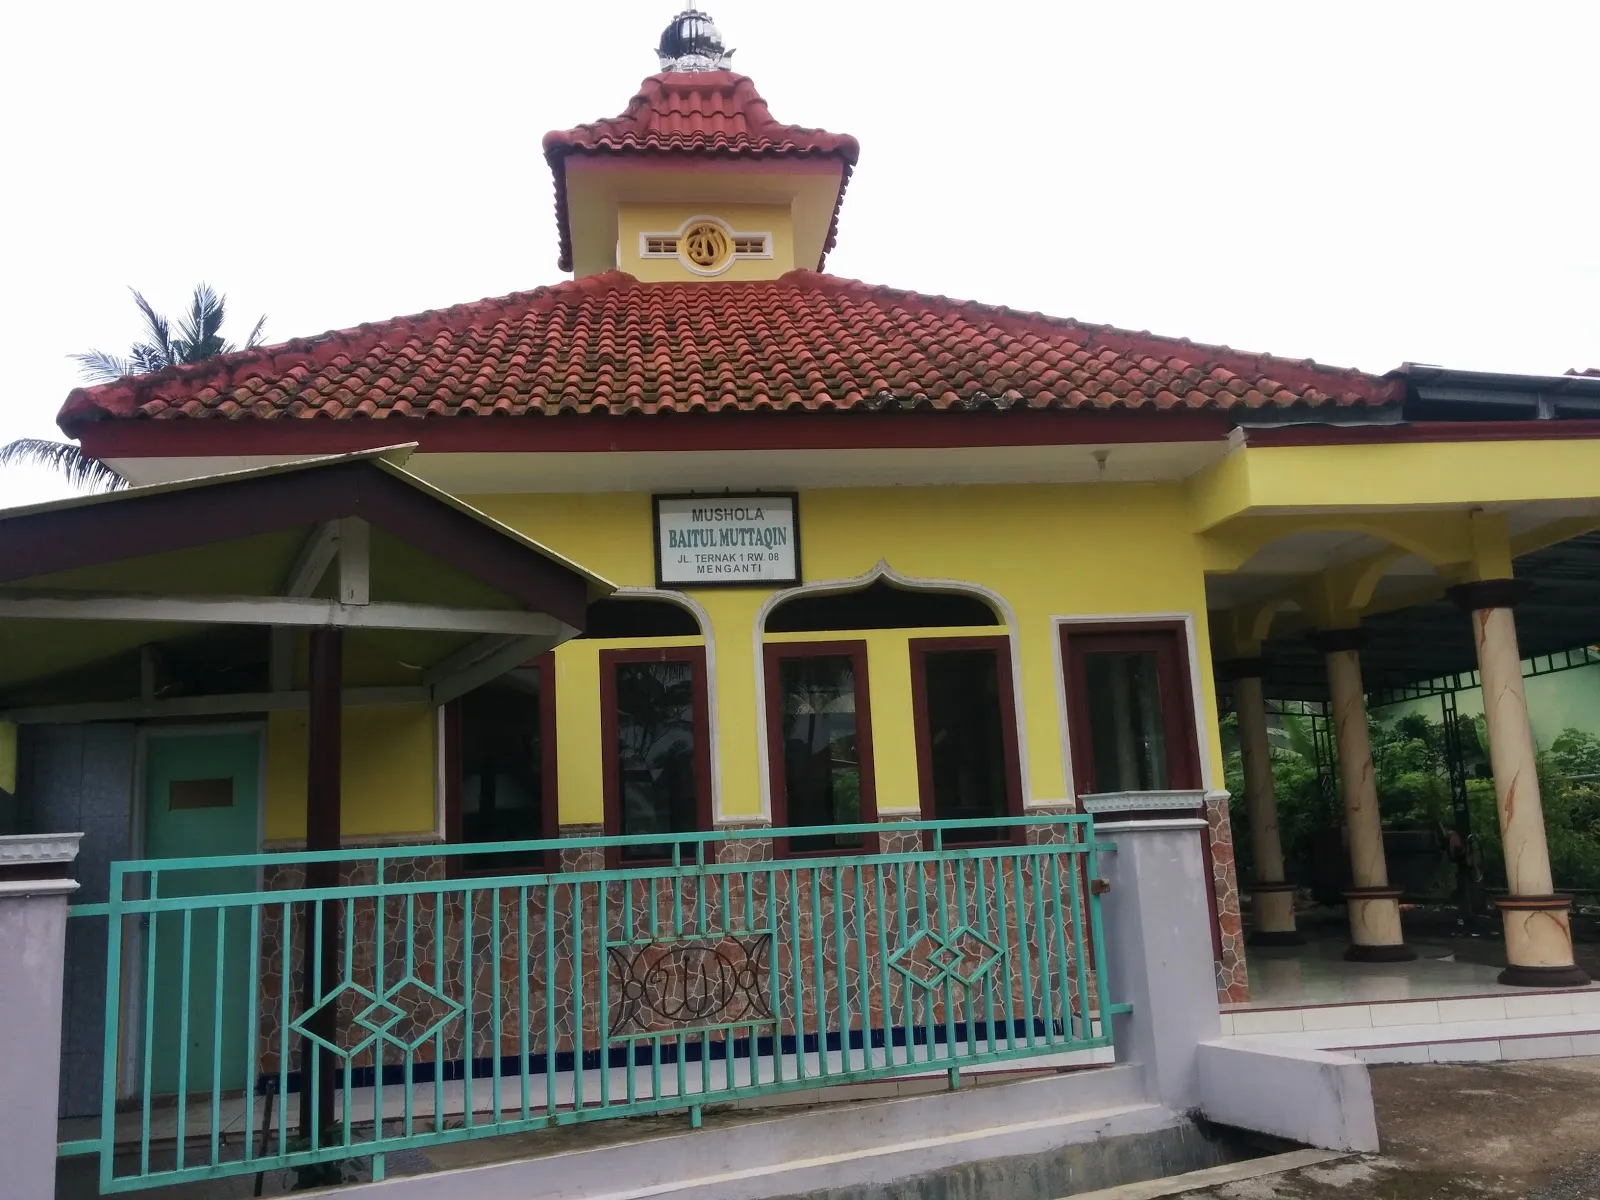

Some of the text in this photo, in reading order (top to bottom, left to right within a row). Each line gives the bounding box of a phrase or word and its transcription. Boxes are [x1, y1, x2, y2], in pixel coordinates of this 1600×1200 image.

[692, 507, 764, 522] MUSHOLA
[668, 526, 787, 550] BAITUL MUTTAQIN
[677, 552, 780, 563] JL. TERNAK 1 RW. 08
[696, 563, 762, 574] MENGANTI
